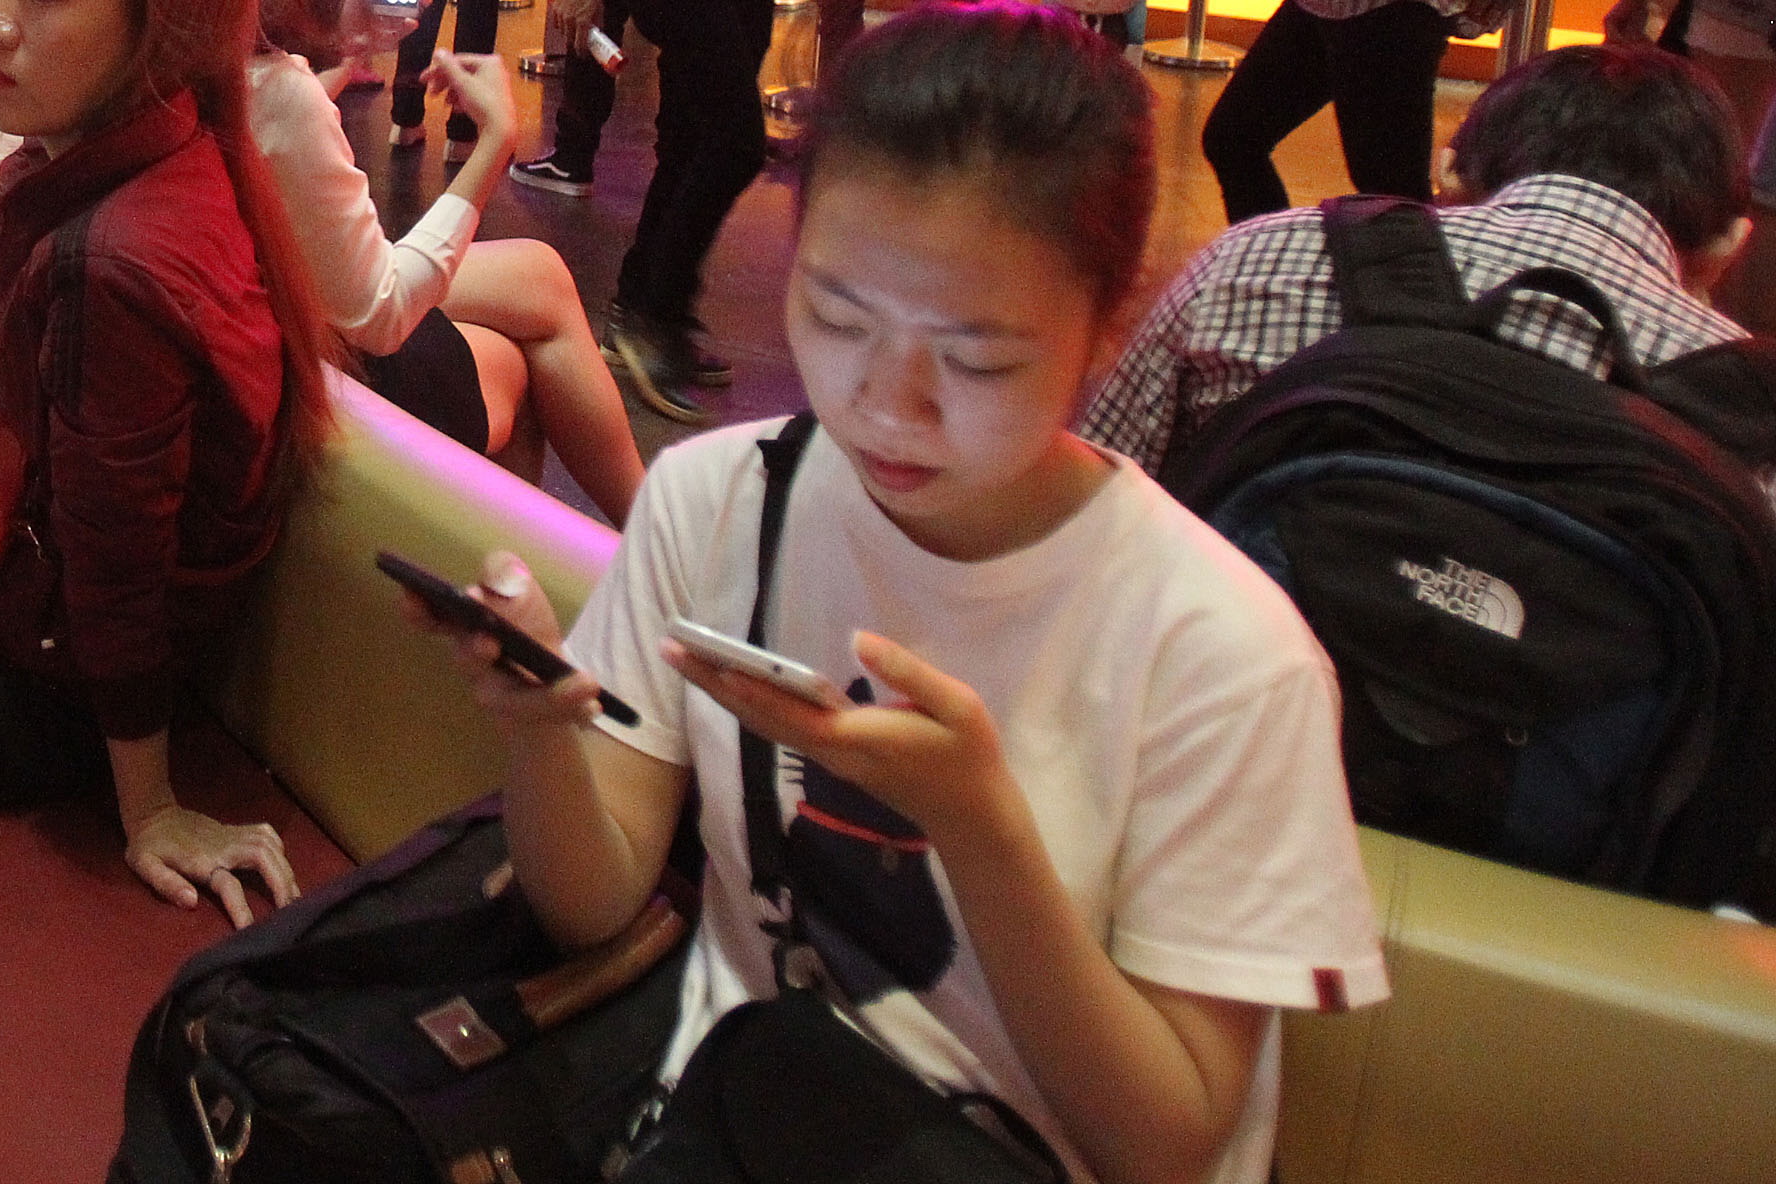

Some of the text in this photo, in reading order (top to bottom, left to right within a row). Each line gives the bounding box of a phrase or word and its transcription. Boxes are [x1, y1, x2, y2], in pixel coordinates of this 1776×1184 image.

[1397, 559, 1482, 603] NORTH
[1443, 556, 1491, 590] THE
[1416, 584, 1482, 621] FACE
